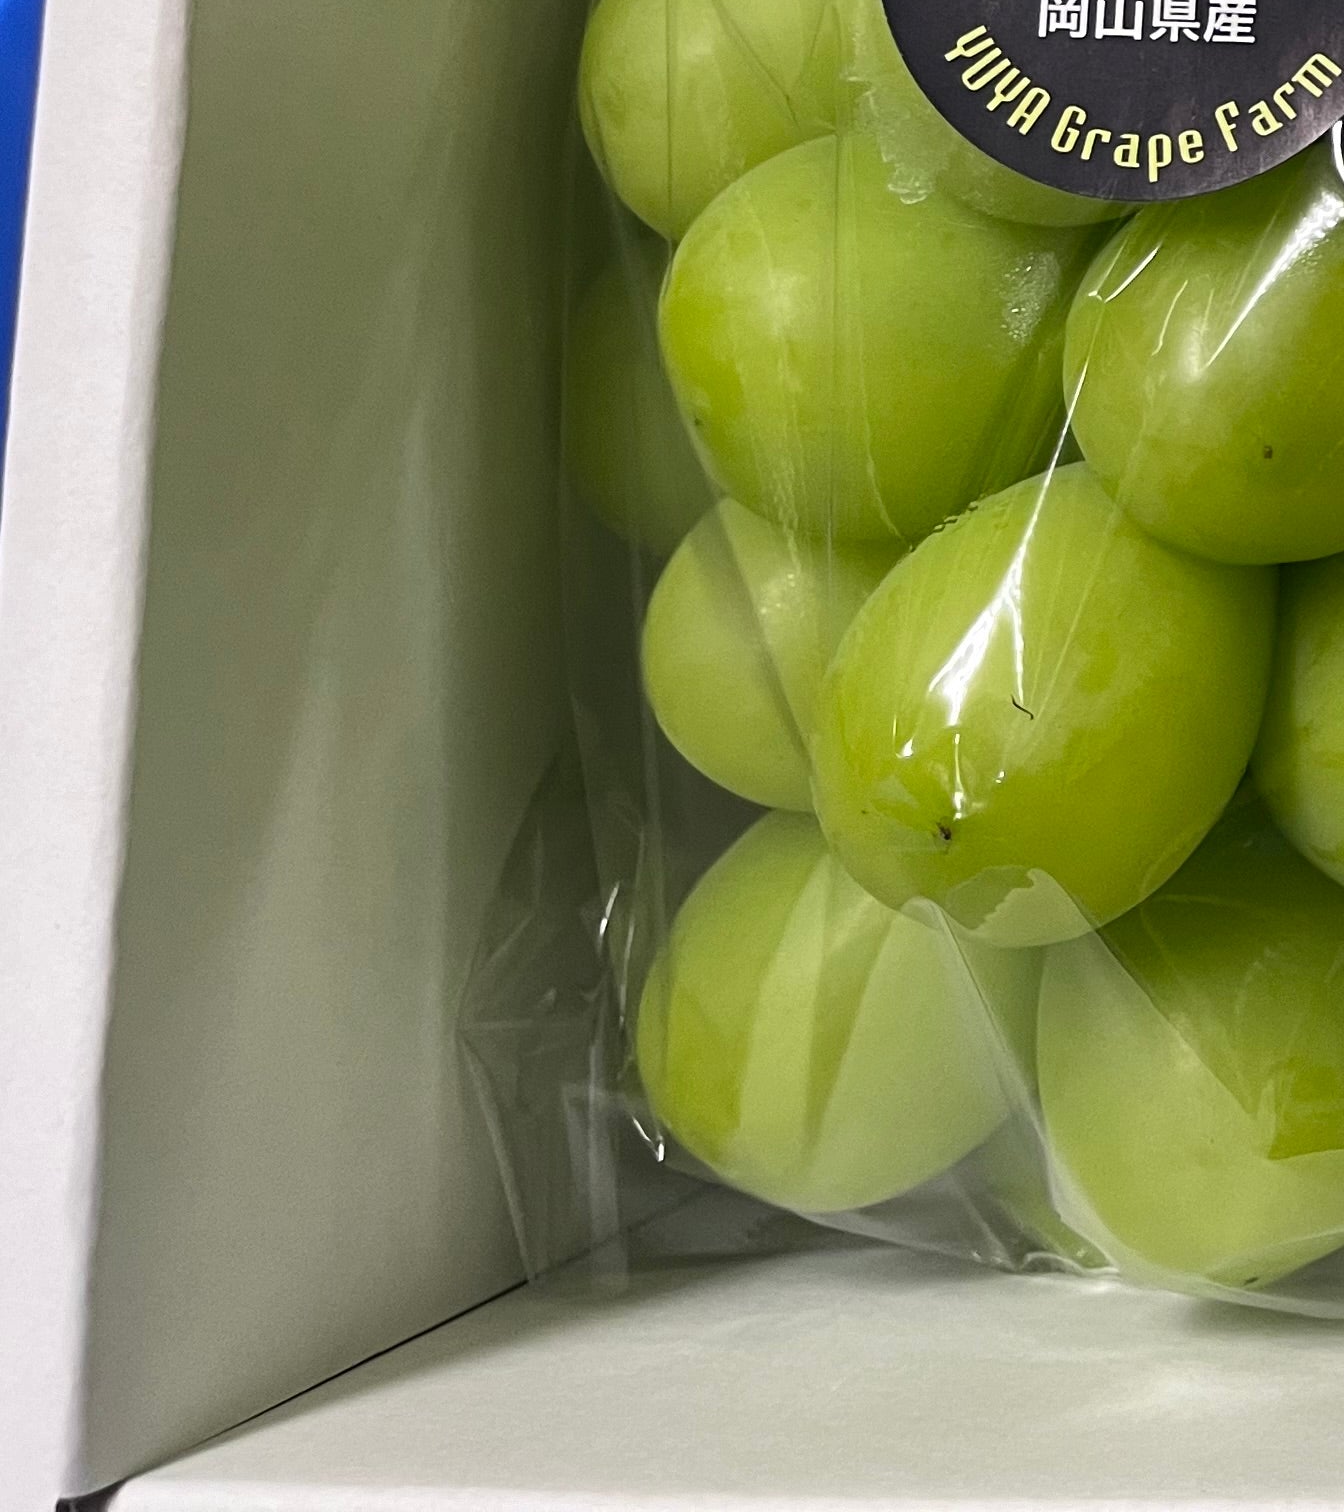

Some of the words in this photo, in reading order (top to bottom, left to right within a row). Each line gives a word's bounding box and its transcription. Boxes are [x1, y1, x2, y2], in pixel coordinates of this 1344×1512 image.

[944, 25, 1052, 137] YUYA
[1050, 104, 1205, 183] Grape
[1214, 52, 1343, 153] Farm
